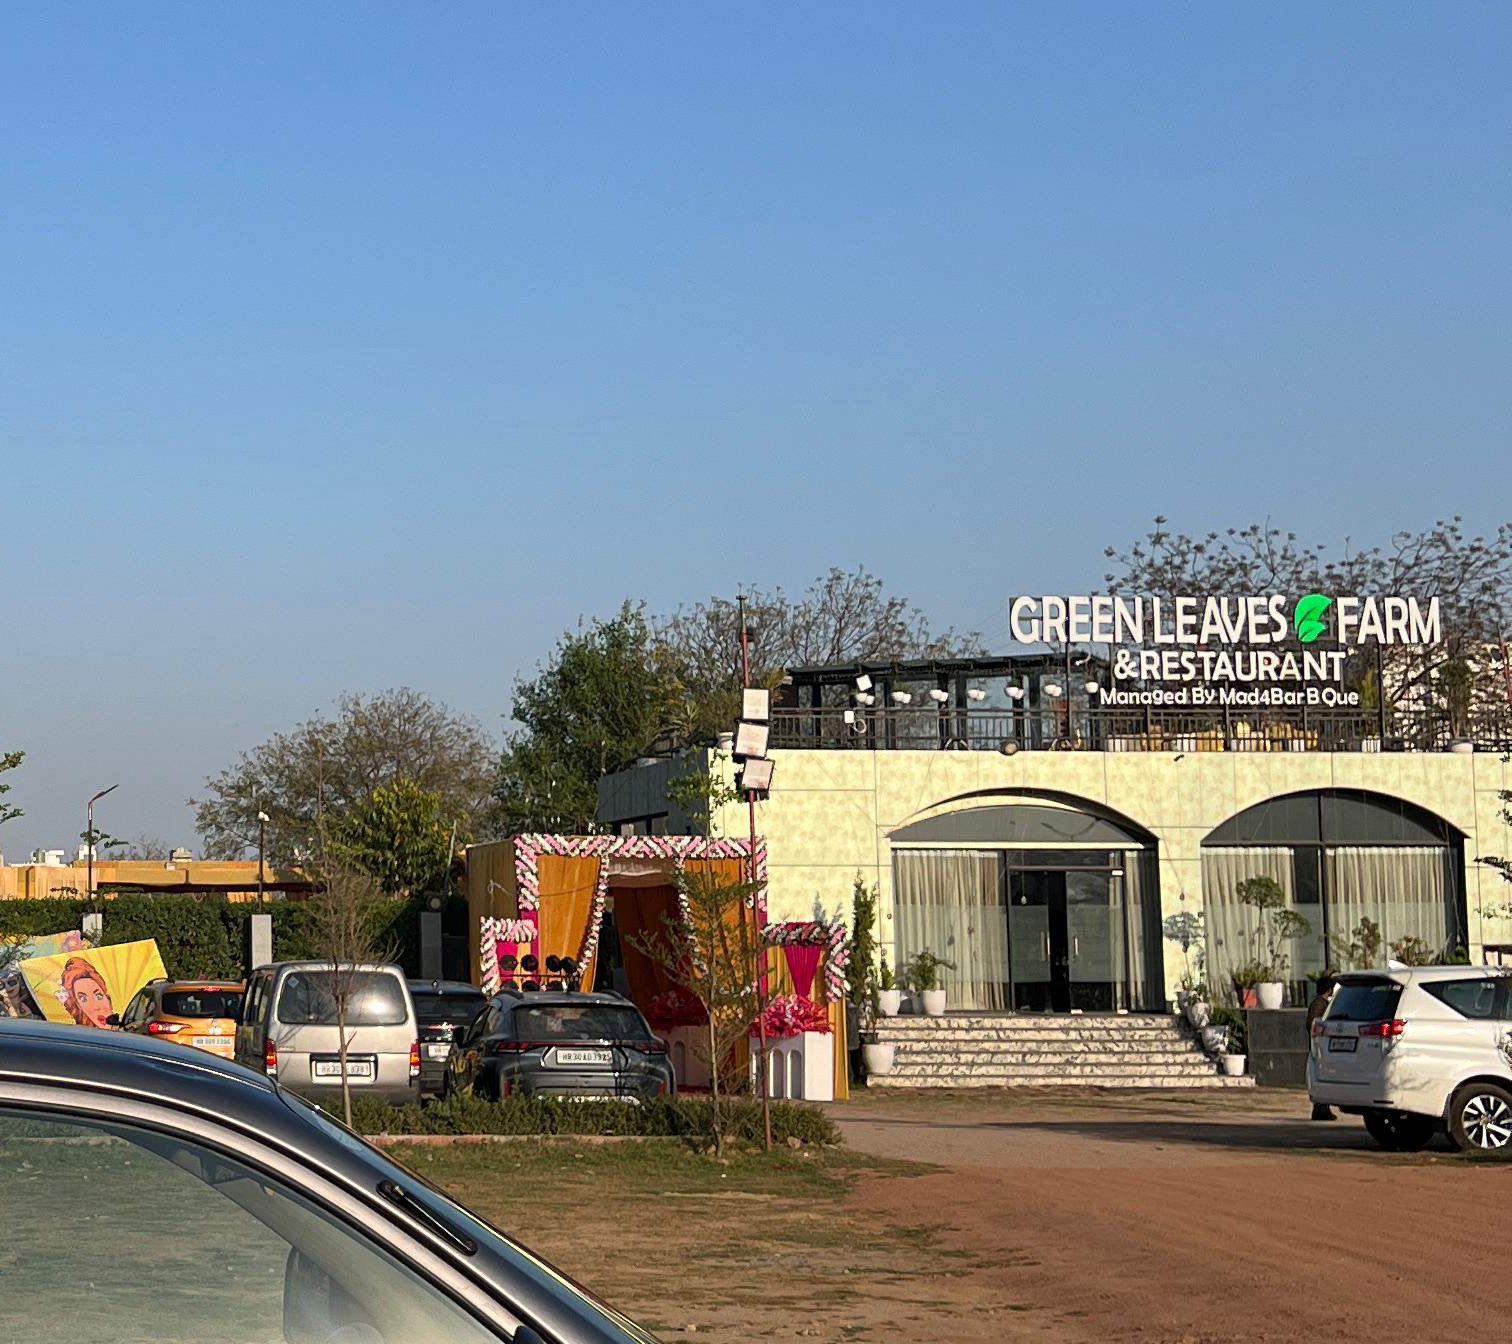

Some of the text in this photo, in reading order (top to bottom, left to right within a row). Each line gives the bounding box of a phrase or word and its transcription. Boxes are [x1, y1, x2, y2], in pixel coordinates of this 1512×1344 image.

[1010, 595, 1441, 644] GREEN LEAVES FARM
[1099, 687, 1187, 705] Managed
[1191, 687, 1216, 706] By
